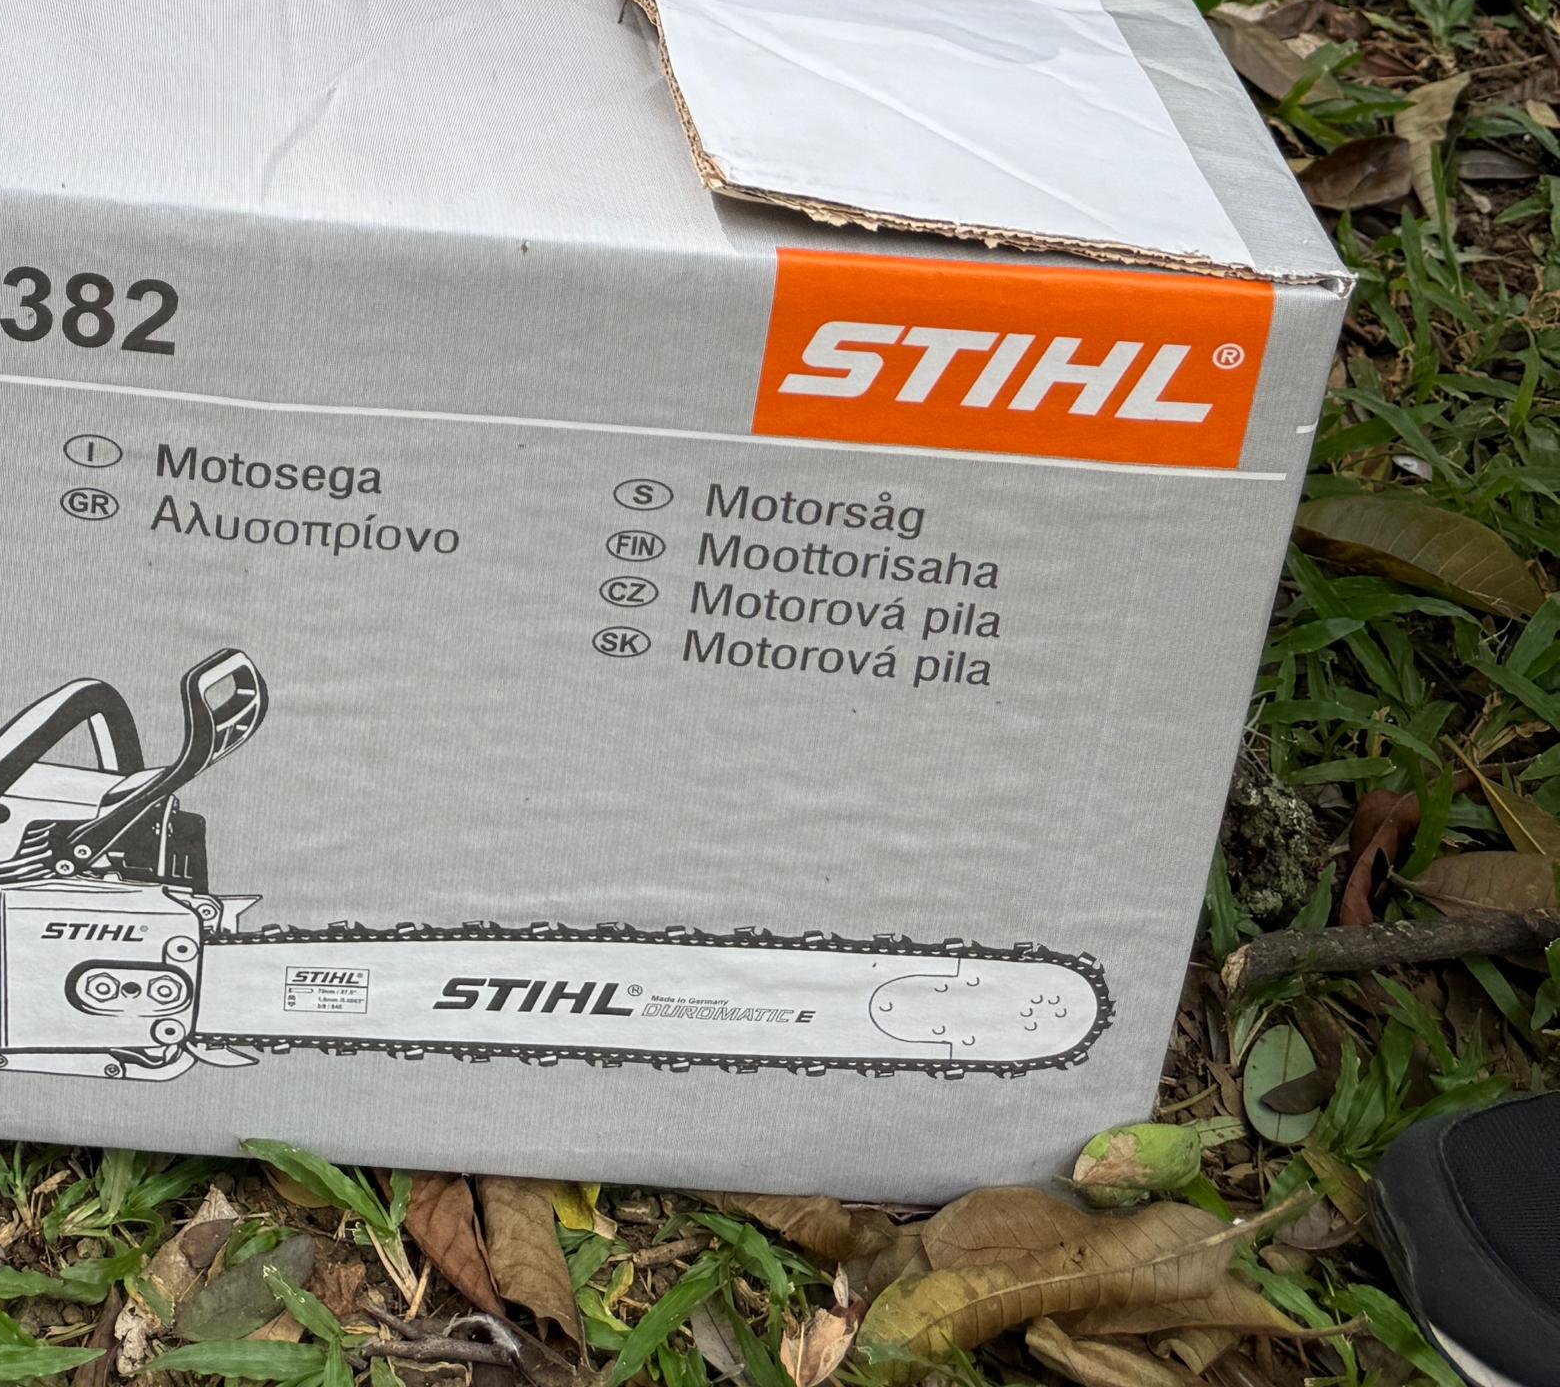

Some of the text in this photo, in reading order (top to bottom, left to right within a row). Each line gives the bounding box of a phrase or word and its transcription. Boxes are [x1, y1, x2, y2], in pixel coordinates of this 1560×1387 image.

[0, 265, 181, 355] 382
[778, 321, 1213, 424] STIHL
[156, 443, 382, 499] Motosega
[68, 492, 110, 515] GR
[705, 483, 926, 540] Motorsåg
[615, 532, 999, 589] FIN Moottorisaha
[607, 581, 1001, 640] CZ Motorová pila
[600, 629, 991, 688] SK Motorová pila
[41, 922, 144, 942] STIHL
[292, 970, 360, 984] STIHL
[432, 977, 634, 1017] STIHL
[641, 1003, 816, 1023] DUROMATIC E
